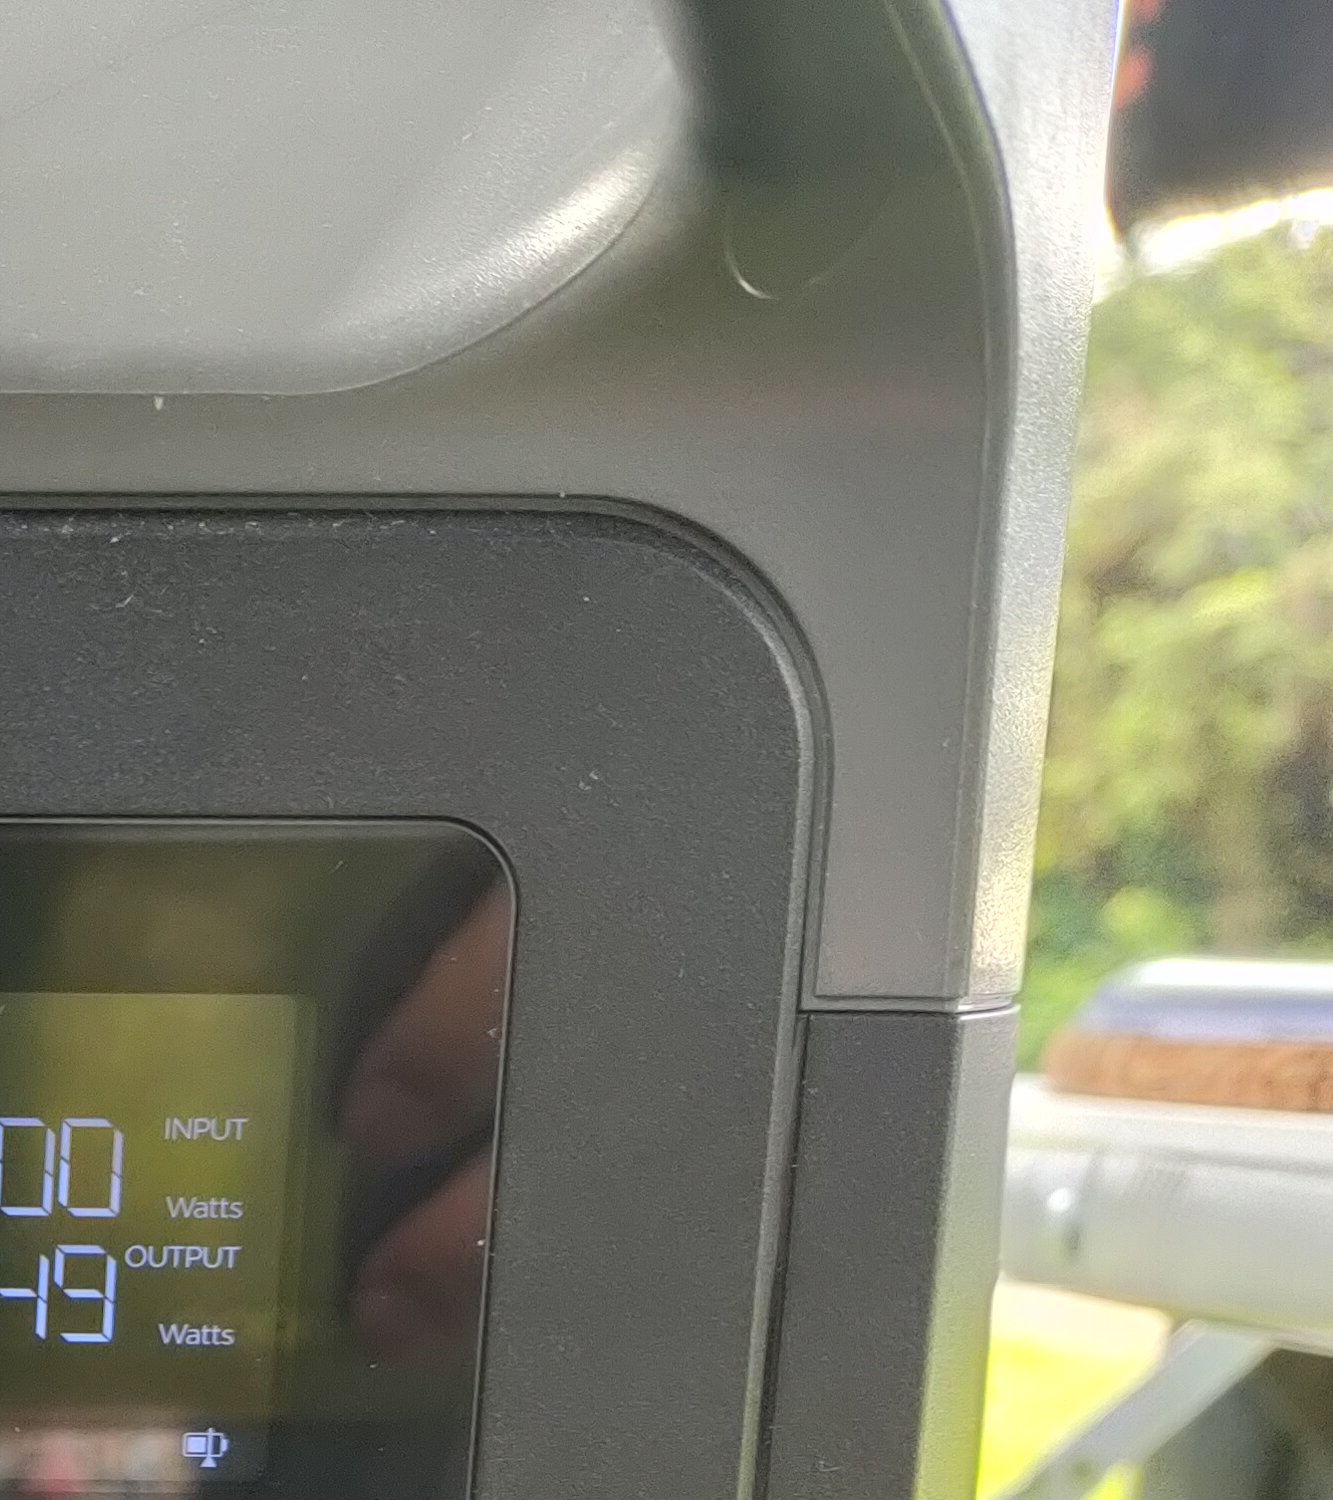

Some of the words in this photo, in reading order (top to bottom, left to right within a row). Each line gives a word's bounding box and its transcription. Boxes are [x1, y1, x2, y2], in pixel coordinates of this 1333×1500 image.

[164, 1118, 248, 1142] INPUT
[166, 1196, 244, 1221] Watts
[124, 1245, 242, 1269] OUTPUT
[158, 1323, 235, 1347] Watts
